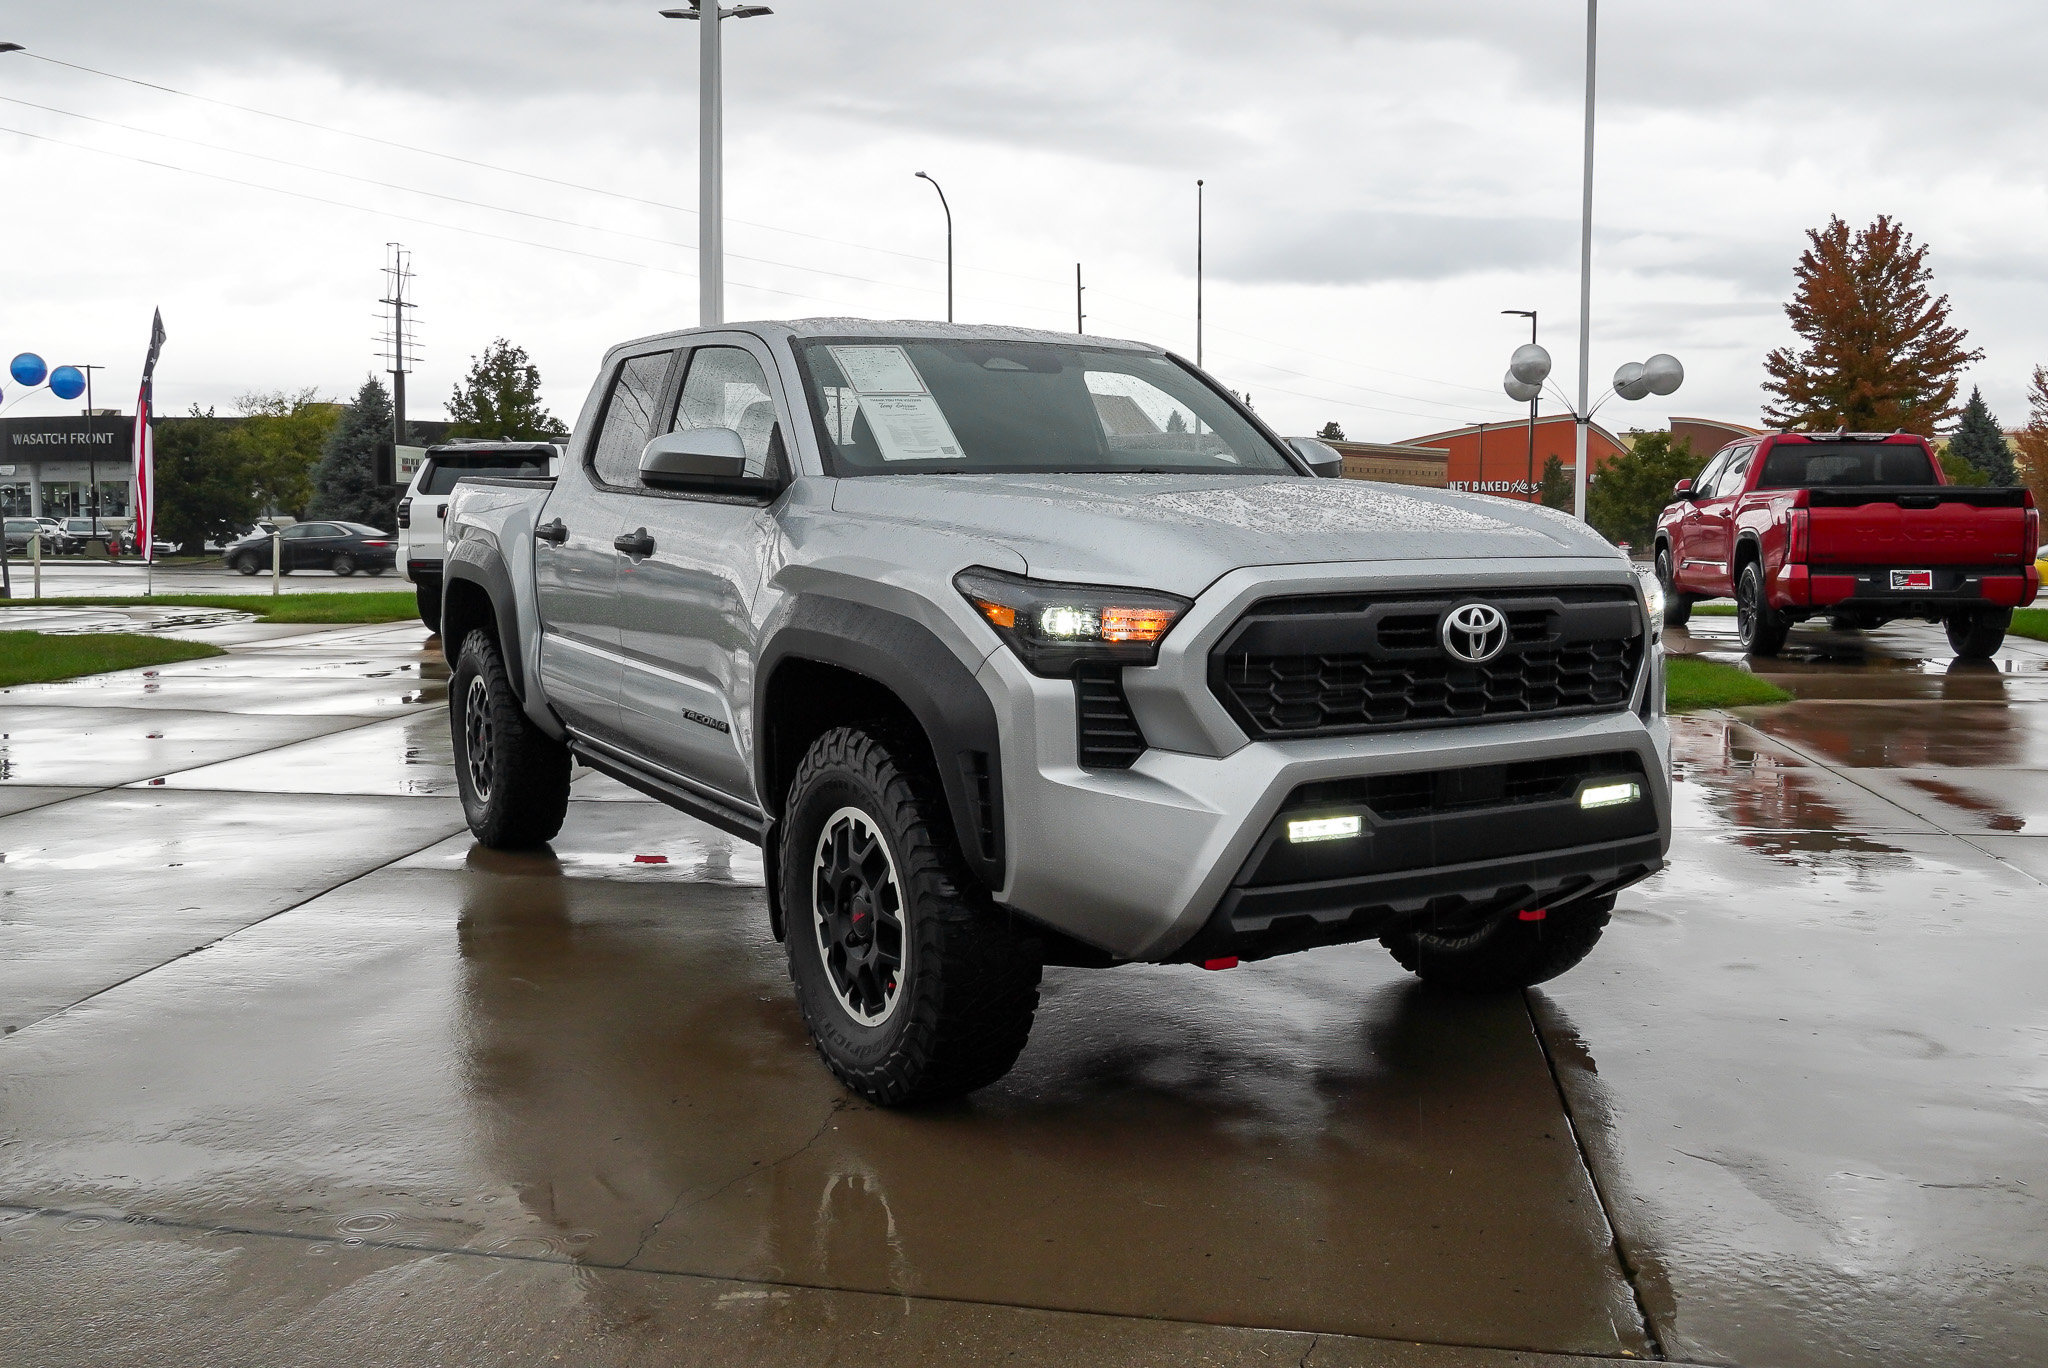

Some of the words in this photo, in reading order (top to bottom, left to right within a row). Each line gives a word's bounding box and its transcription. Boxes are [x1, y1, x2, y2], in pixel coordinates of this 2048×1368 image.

[12, 433, 67, 445] WASATCH
[70, 432, 114, 445] FRONT
[1472, 480, 1510, 492] BAKED
[1856, 528, 1979, 542] TUNDRA
[681, 707, 730, 734] TACOMA
